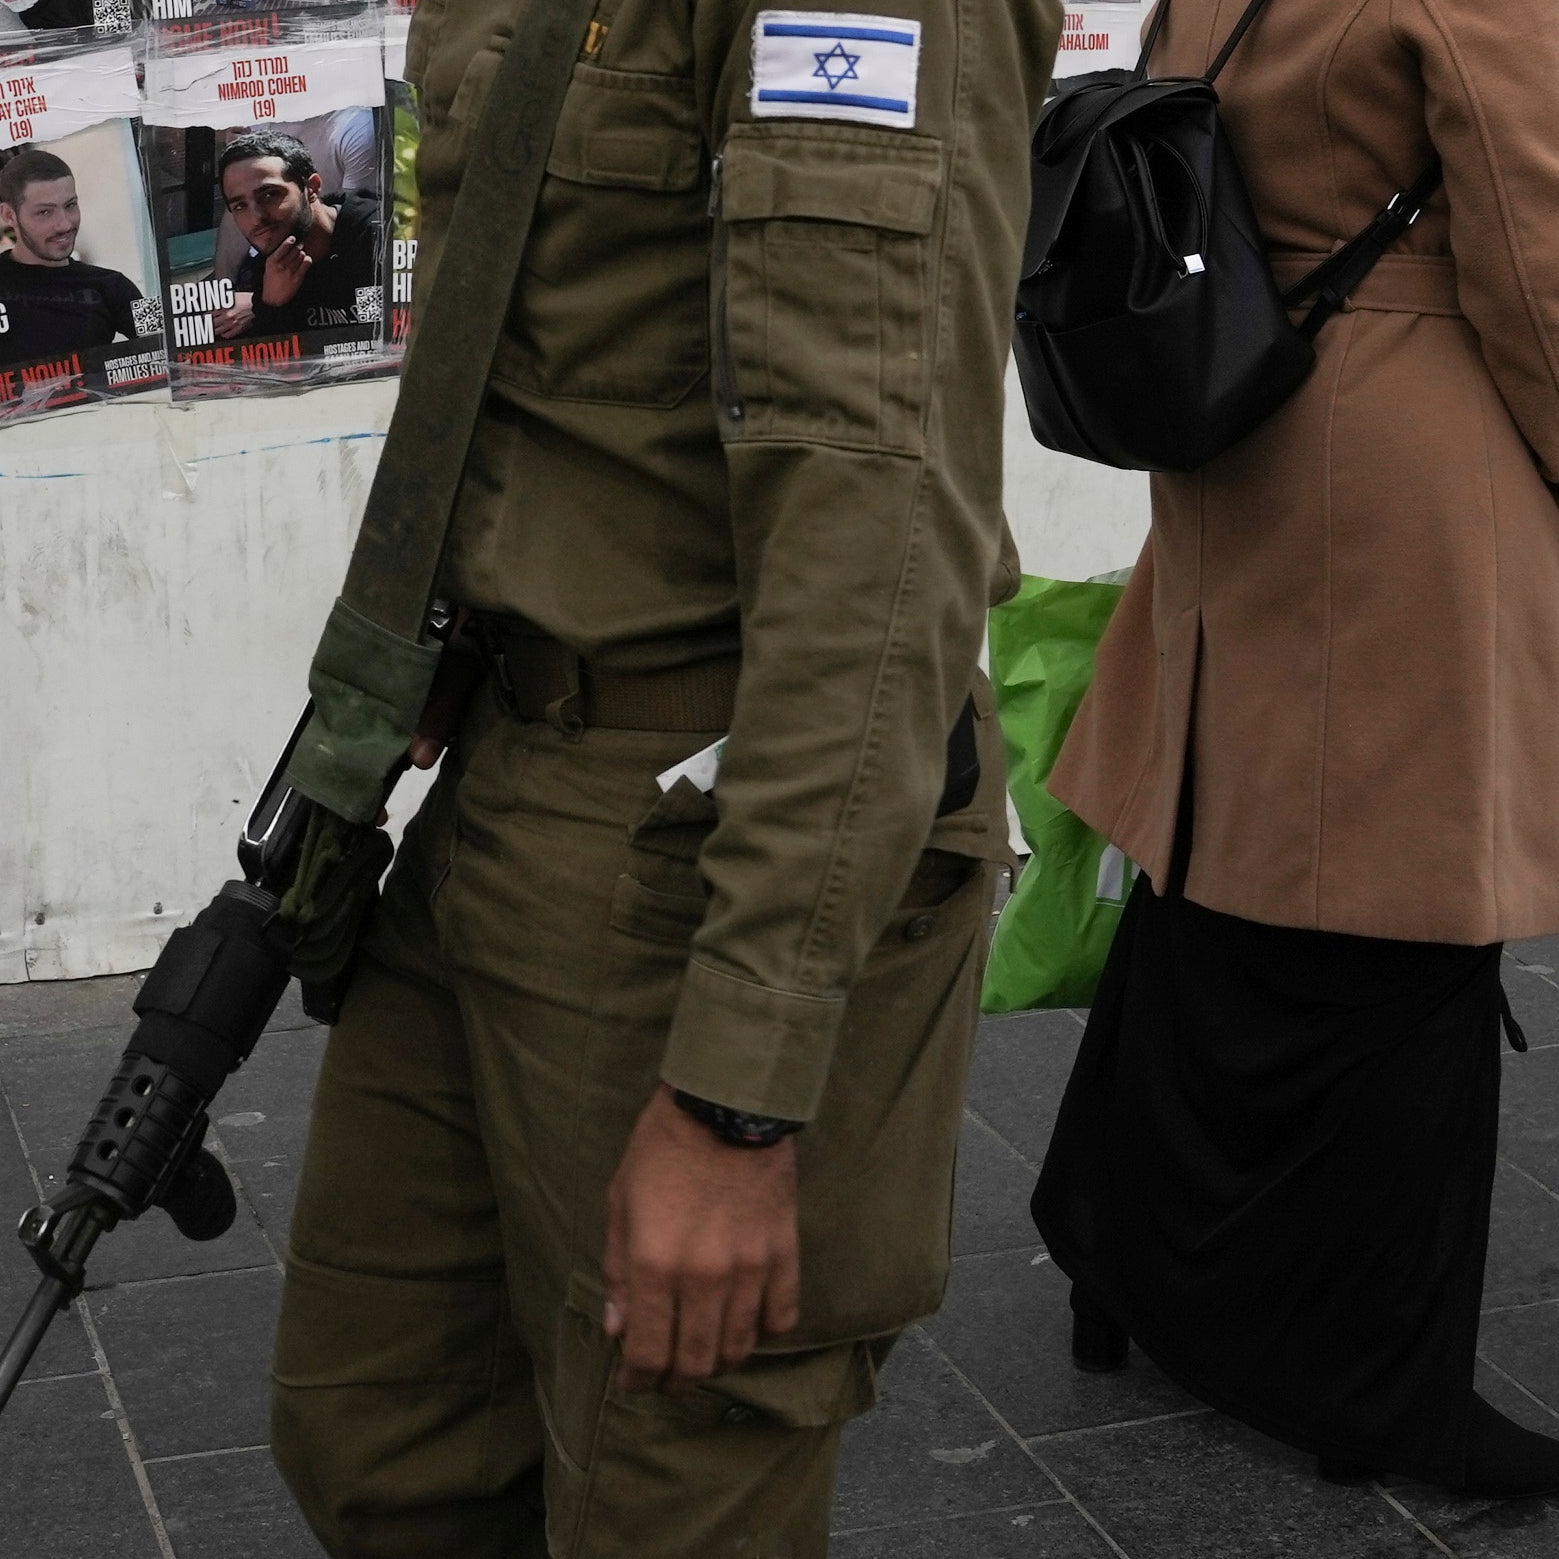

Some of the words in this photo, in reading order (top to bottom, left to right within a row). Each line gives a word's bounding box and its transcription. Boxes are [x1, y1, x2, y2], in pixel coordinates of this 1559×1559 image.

[232, 59, 253, 80] כהן
[257, 56, 289, 76] נמרוד
[218, 79, 265, 100] NIMROD
[267, 75, 307, 96] COHEN
[15, 95, 48, 117] CHEN
